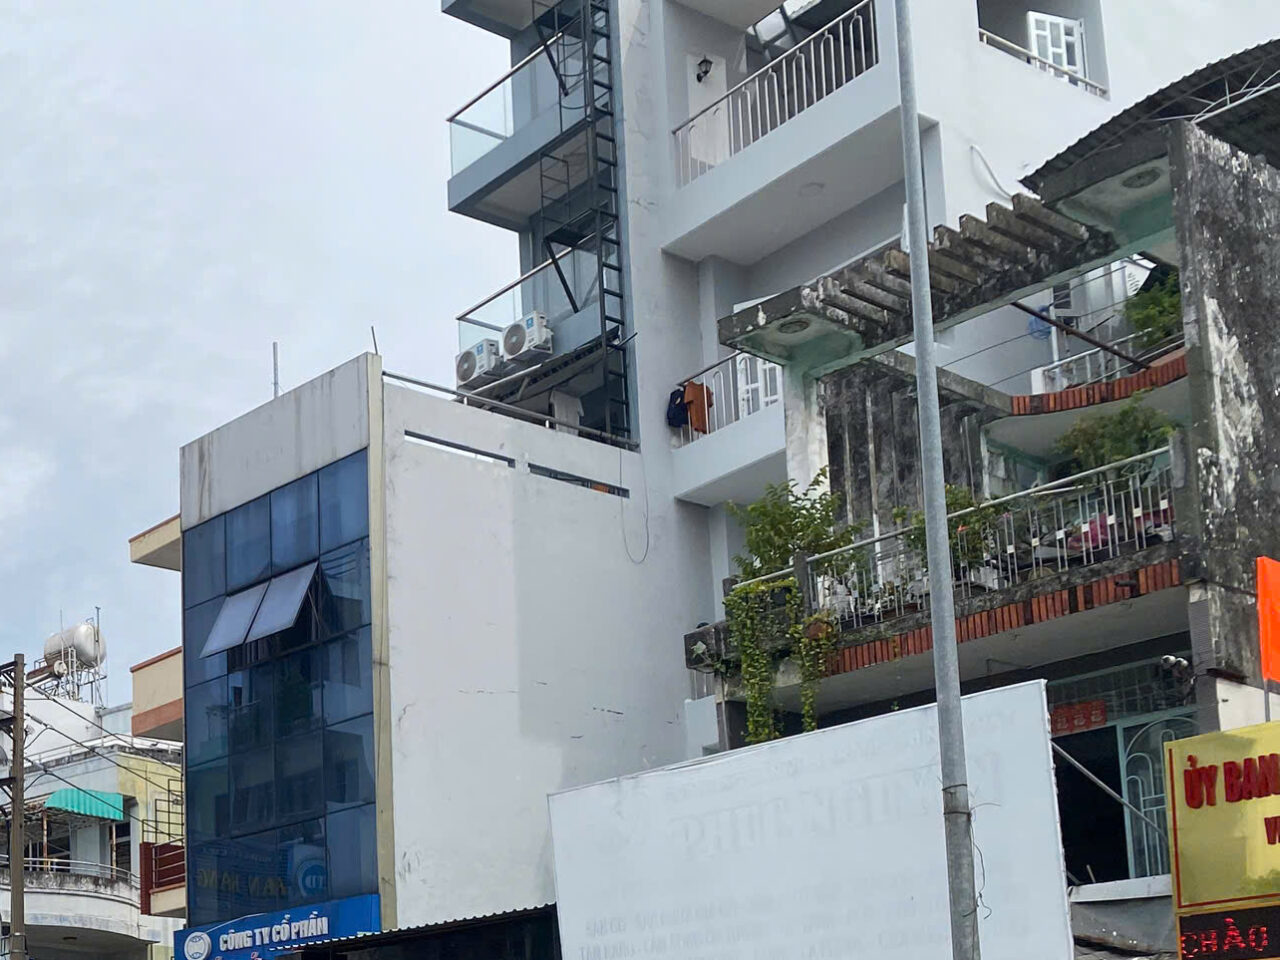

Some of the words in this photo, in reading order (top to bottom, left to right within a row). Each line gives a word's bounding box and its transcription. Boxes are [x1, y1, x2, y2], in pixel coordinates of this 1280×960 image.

[1183, 755, 1218, 809] ỦY
[219, 929, 253, 951] CÔNG
[254, 926, 270, 946] TY
[271, 914, 291, 942] CỔ
[291, 911, 329, 939] PHẦN
[1181, 917, 1269, 958] CHÀO
